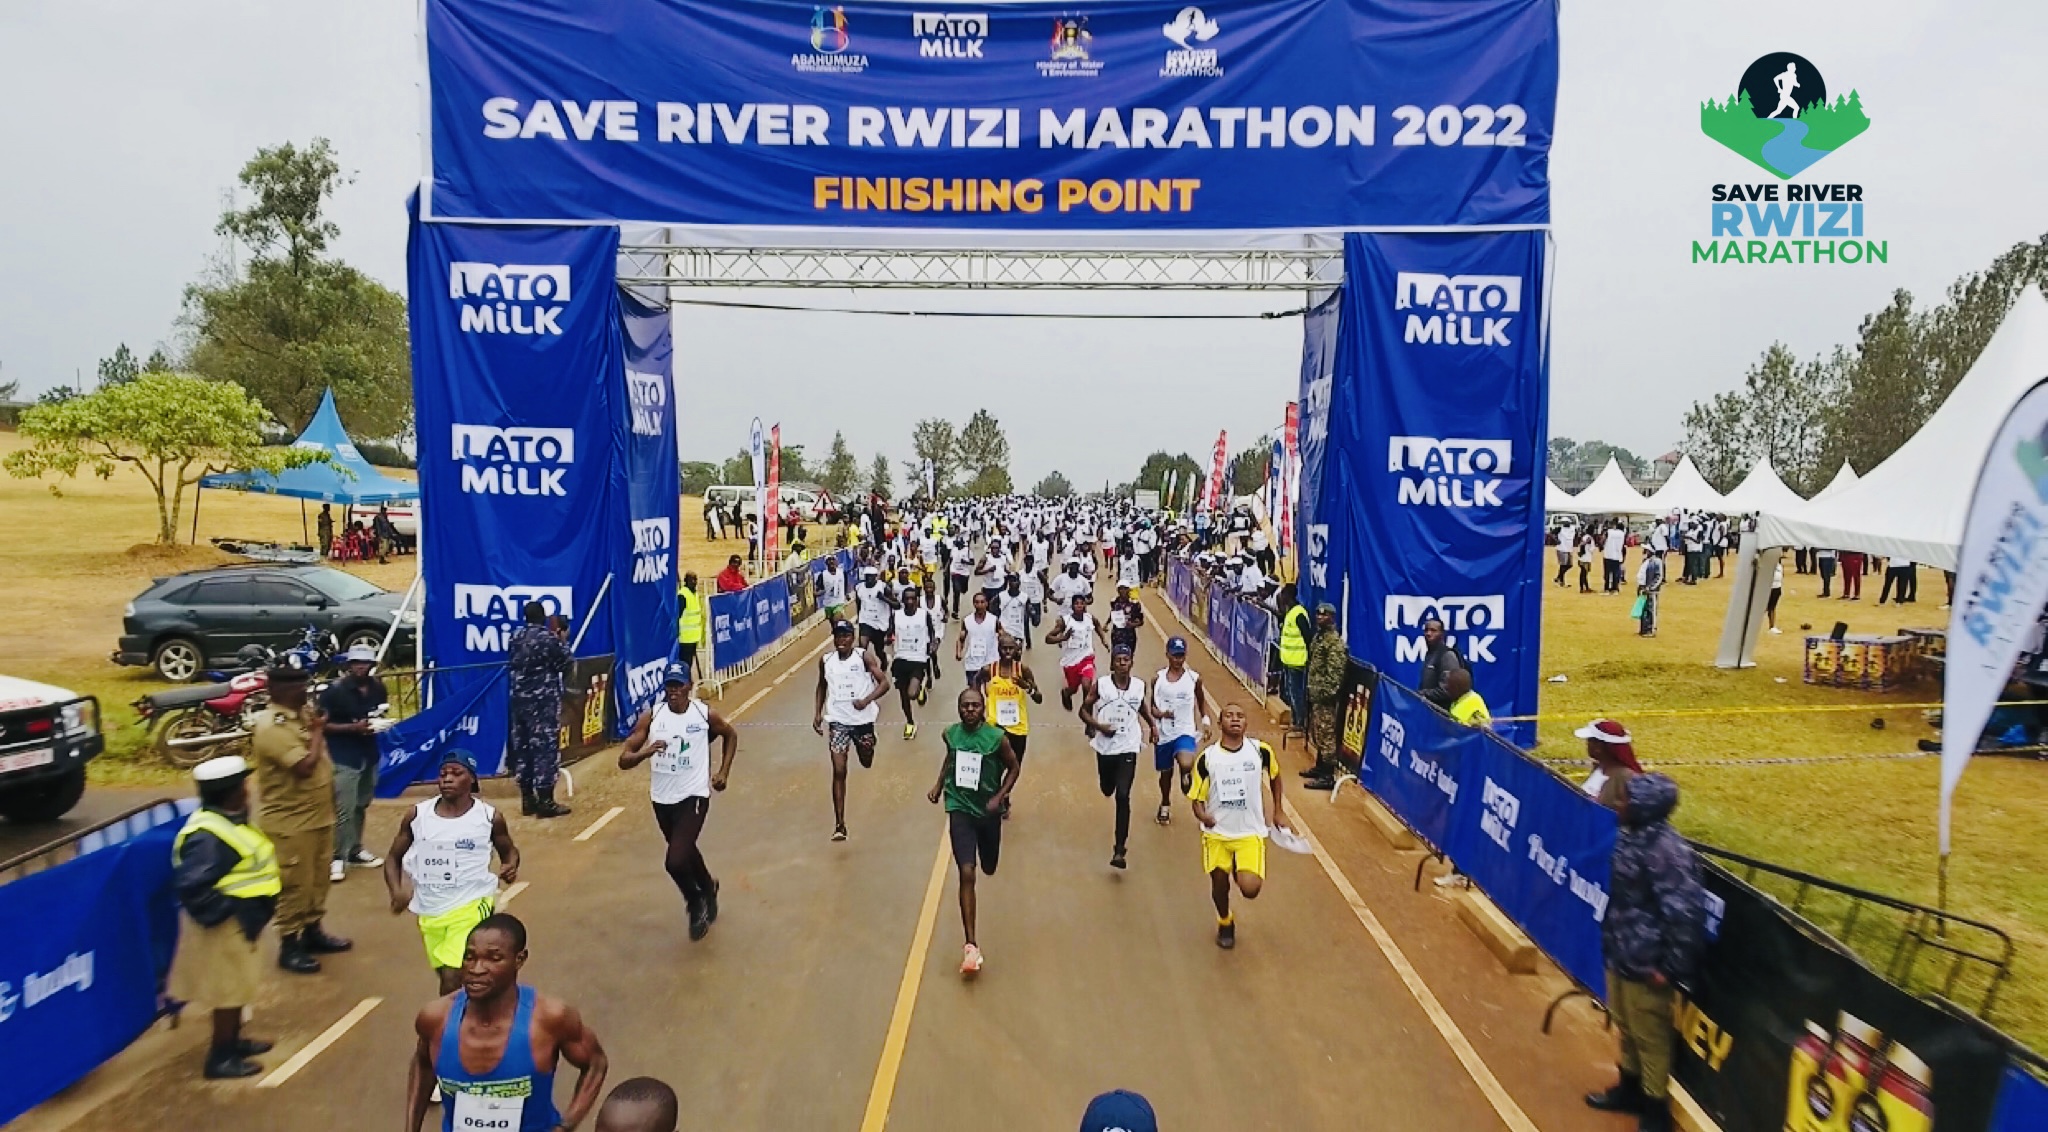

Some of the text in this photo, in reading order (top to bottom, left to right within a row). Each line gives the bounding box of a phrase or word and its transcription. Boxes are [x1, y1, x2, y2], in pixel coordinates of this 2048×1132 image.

[920, 18, 982, 37] LATO
[791, 53, 870, 67] ABAHUMUZA
[1158, 66, 1224, 78] MARATHON
[1165, 53, 1218, 68] RWIZI
[482, 97, 1528, 149] SAVE RIVER RWIZI MARATHON 2022
[813, 176, 1201, 212] FINISHING POINT
[459, 270, 559, 301] LATO
[1408, 281, 1508, 313] LATO
[461, 431, 563, 463] LATO
[1400, 444, 1499, 475] LATO
[465, 592, 563, 621] LATO
[1397, 602, 1493, 631] LATO
[1669, 988, 1734, 1072] NEY
[464, 1116, 509, 1129] 0640
